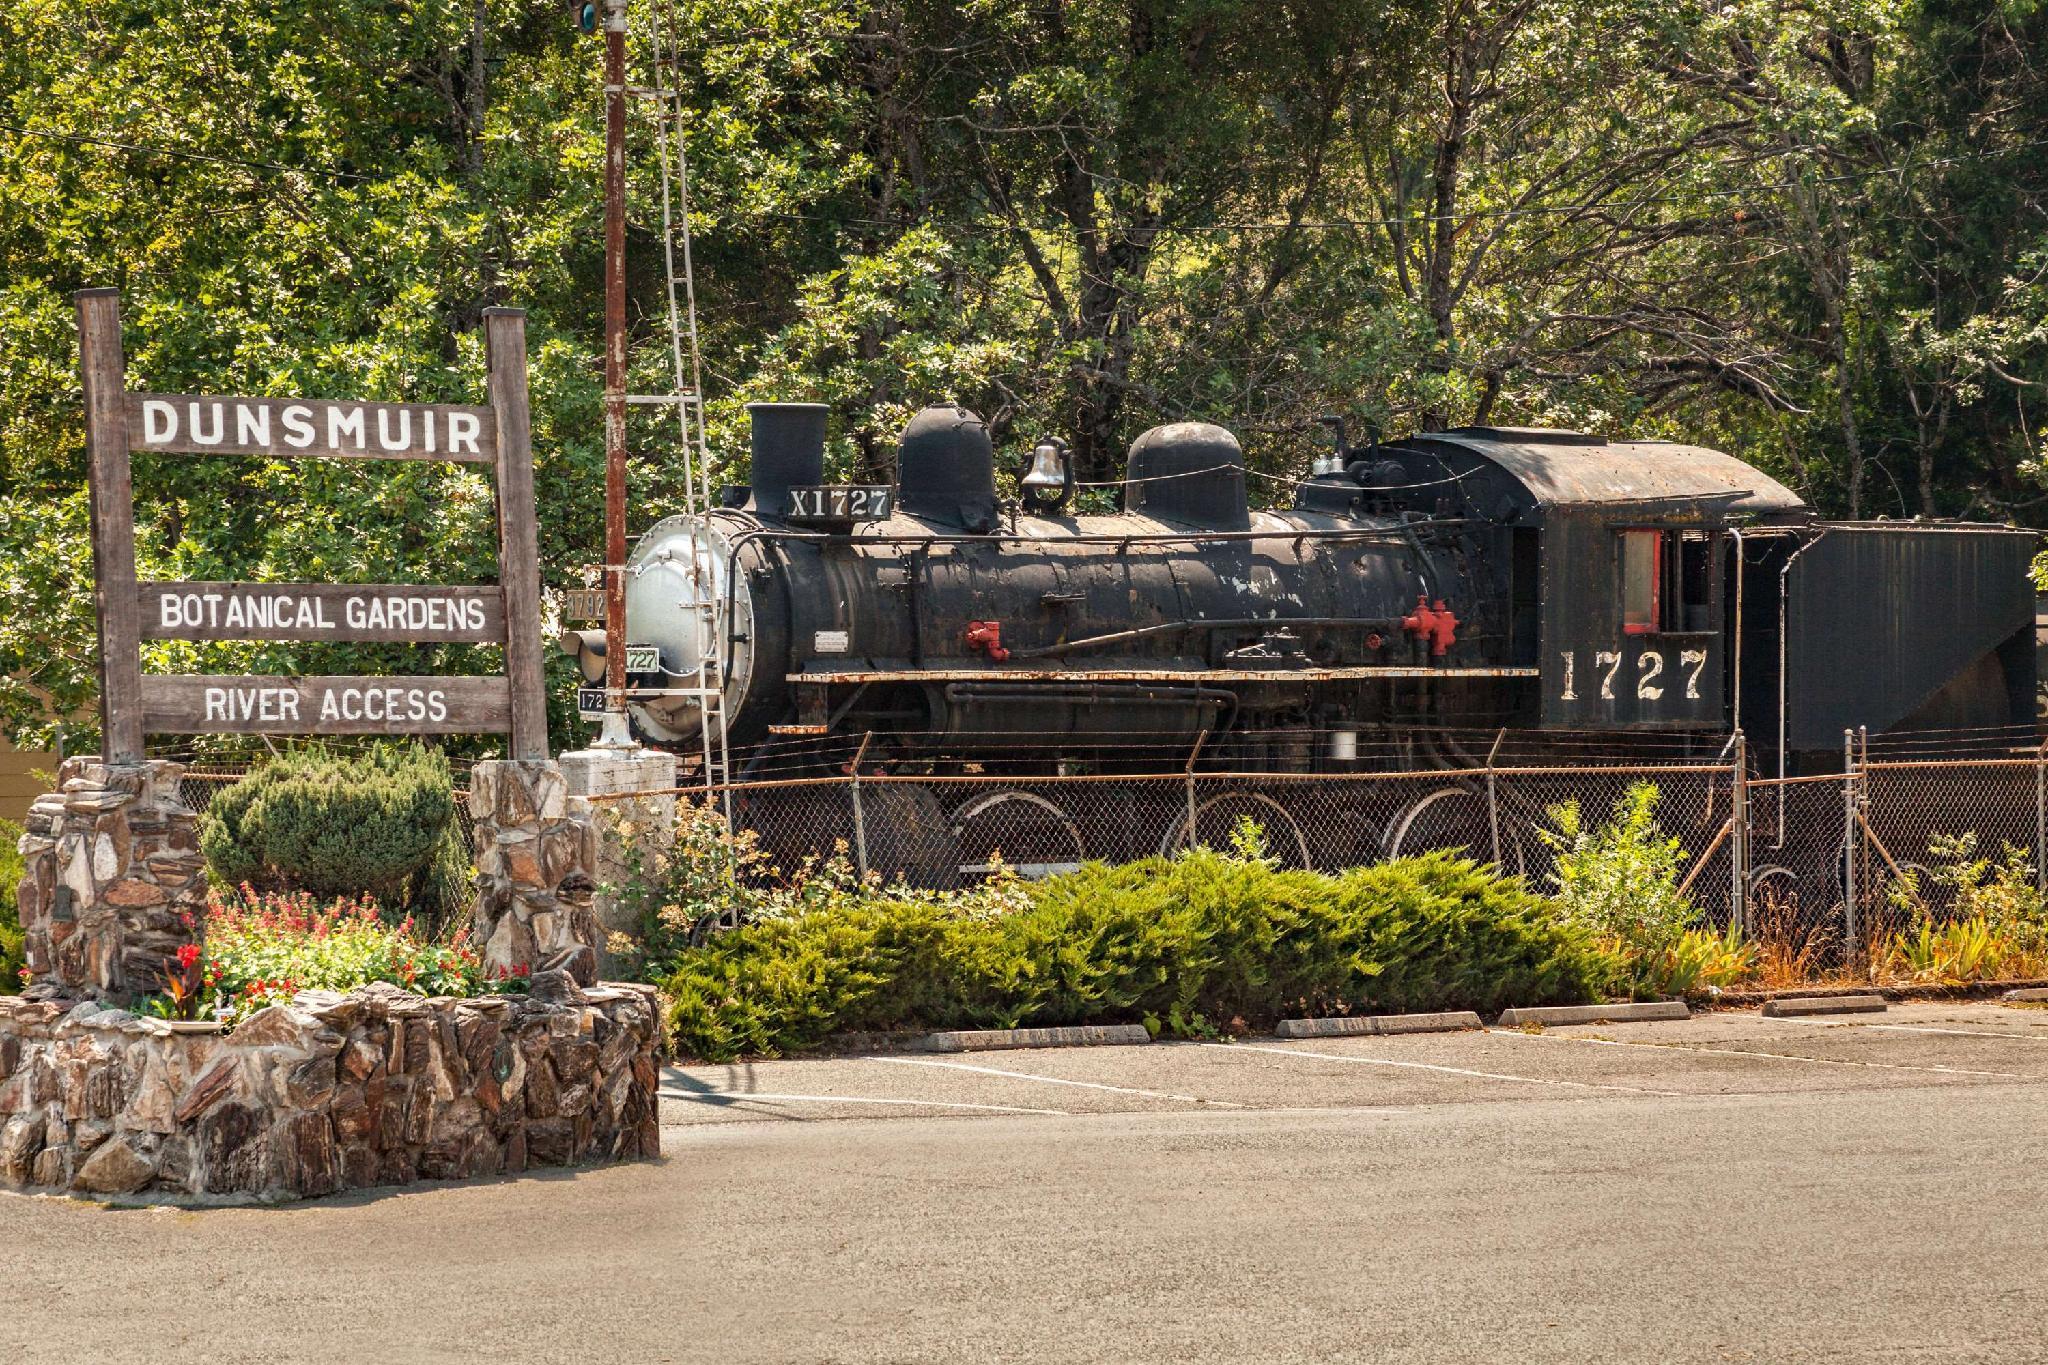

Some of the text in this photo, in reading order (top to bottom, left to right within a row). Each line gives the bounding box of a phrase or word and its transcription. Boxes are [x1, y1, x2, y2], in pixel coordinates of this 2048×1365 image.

[143, 400, 481, 454] DUNSMUIR
[789, 490, 887, 516] X1727
[160, 593, 486, 631] BOTANICAL GARDENS
[626, 650, 656, 669] 727
[1560, 649, 1708, 700] 1727
[205, 687, 447, 722] RIVER ACCESS
[581, 693, 606, 709] 172
